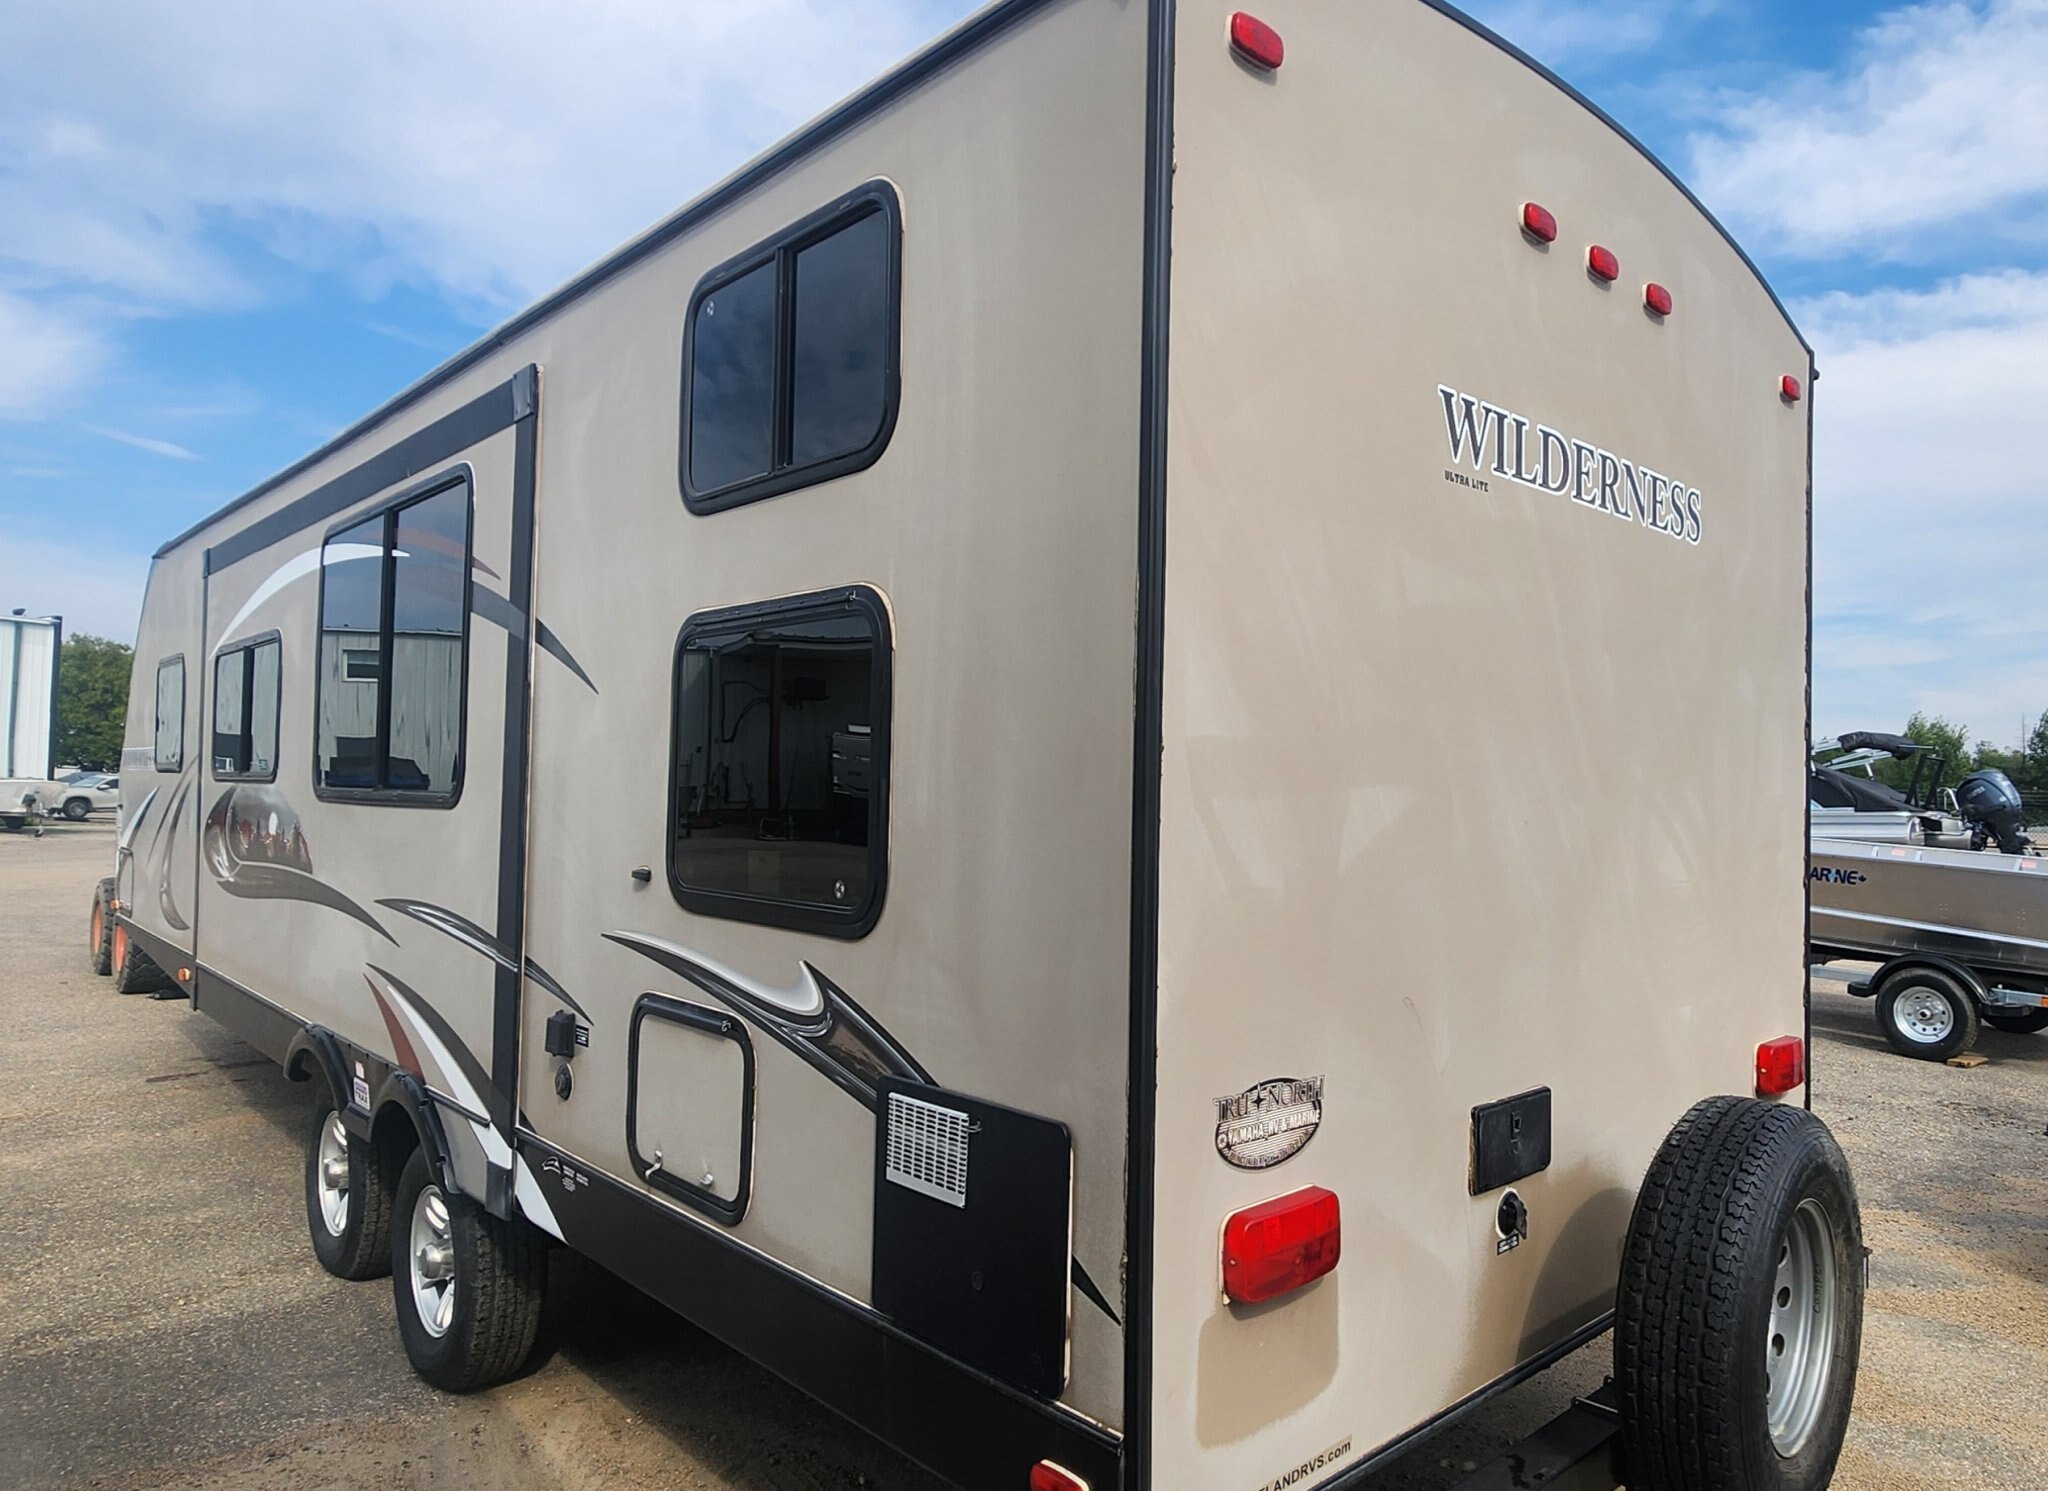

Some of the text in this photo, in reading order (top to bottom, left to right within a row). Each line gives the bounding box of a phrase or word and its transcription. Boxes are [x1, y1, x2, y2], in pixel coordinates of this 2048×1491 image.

[1437, 384, 1702, 545] WILDERNESS
[1444, 470, 1489, 493] ULTRA LITE
[1214, 1077, 1324, 1122] TRU NORTH
[1256, 1441, 1352, 1491] ANDRVS.com
